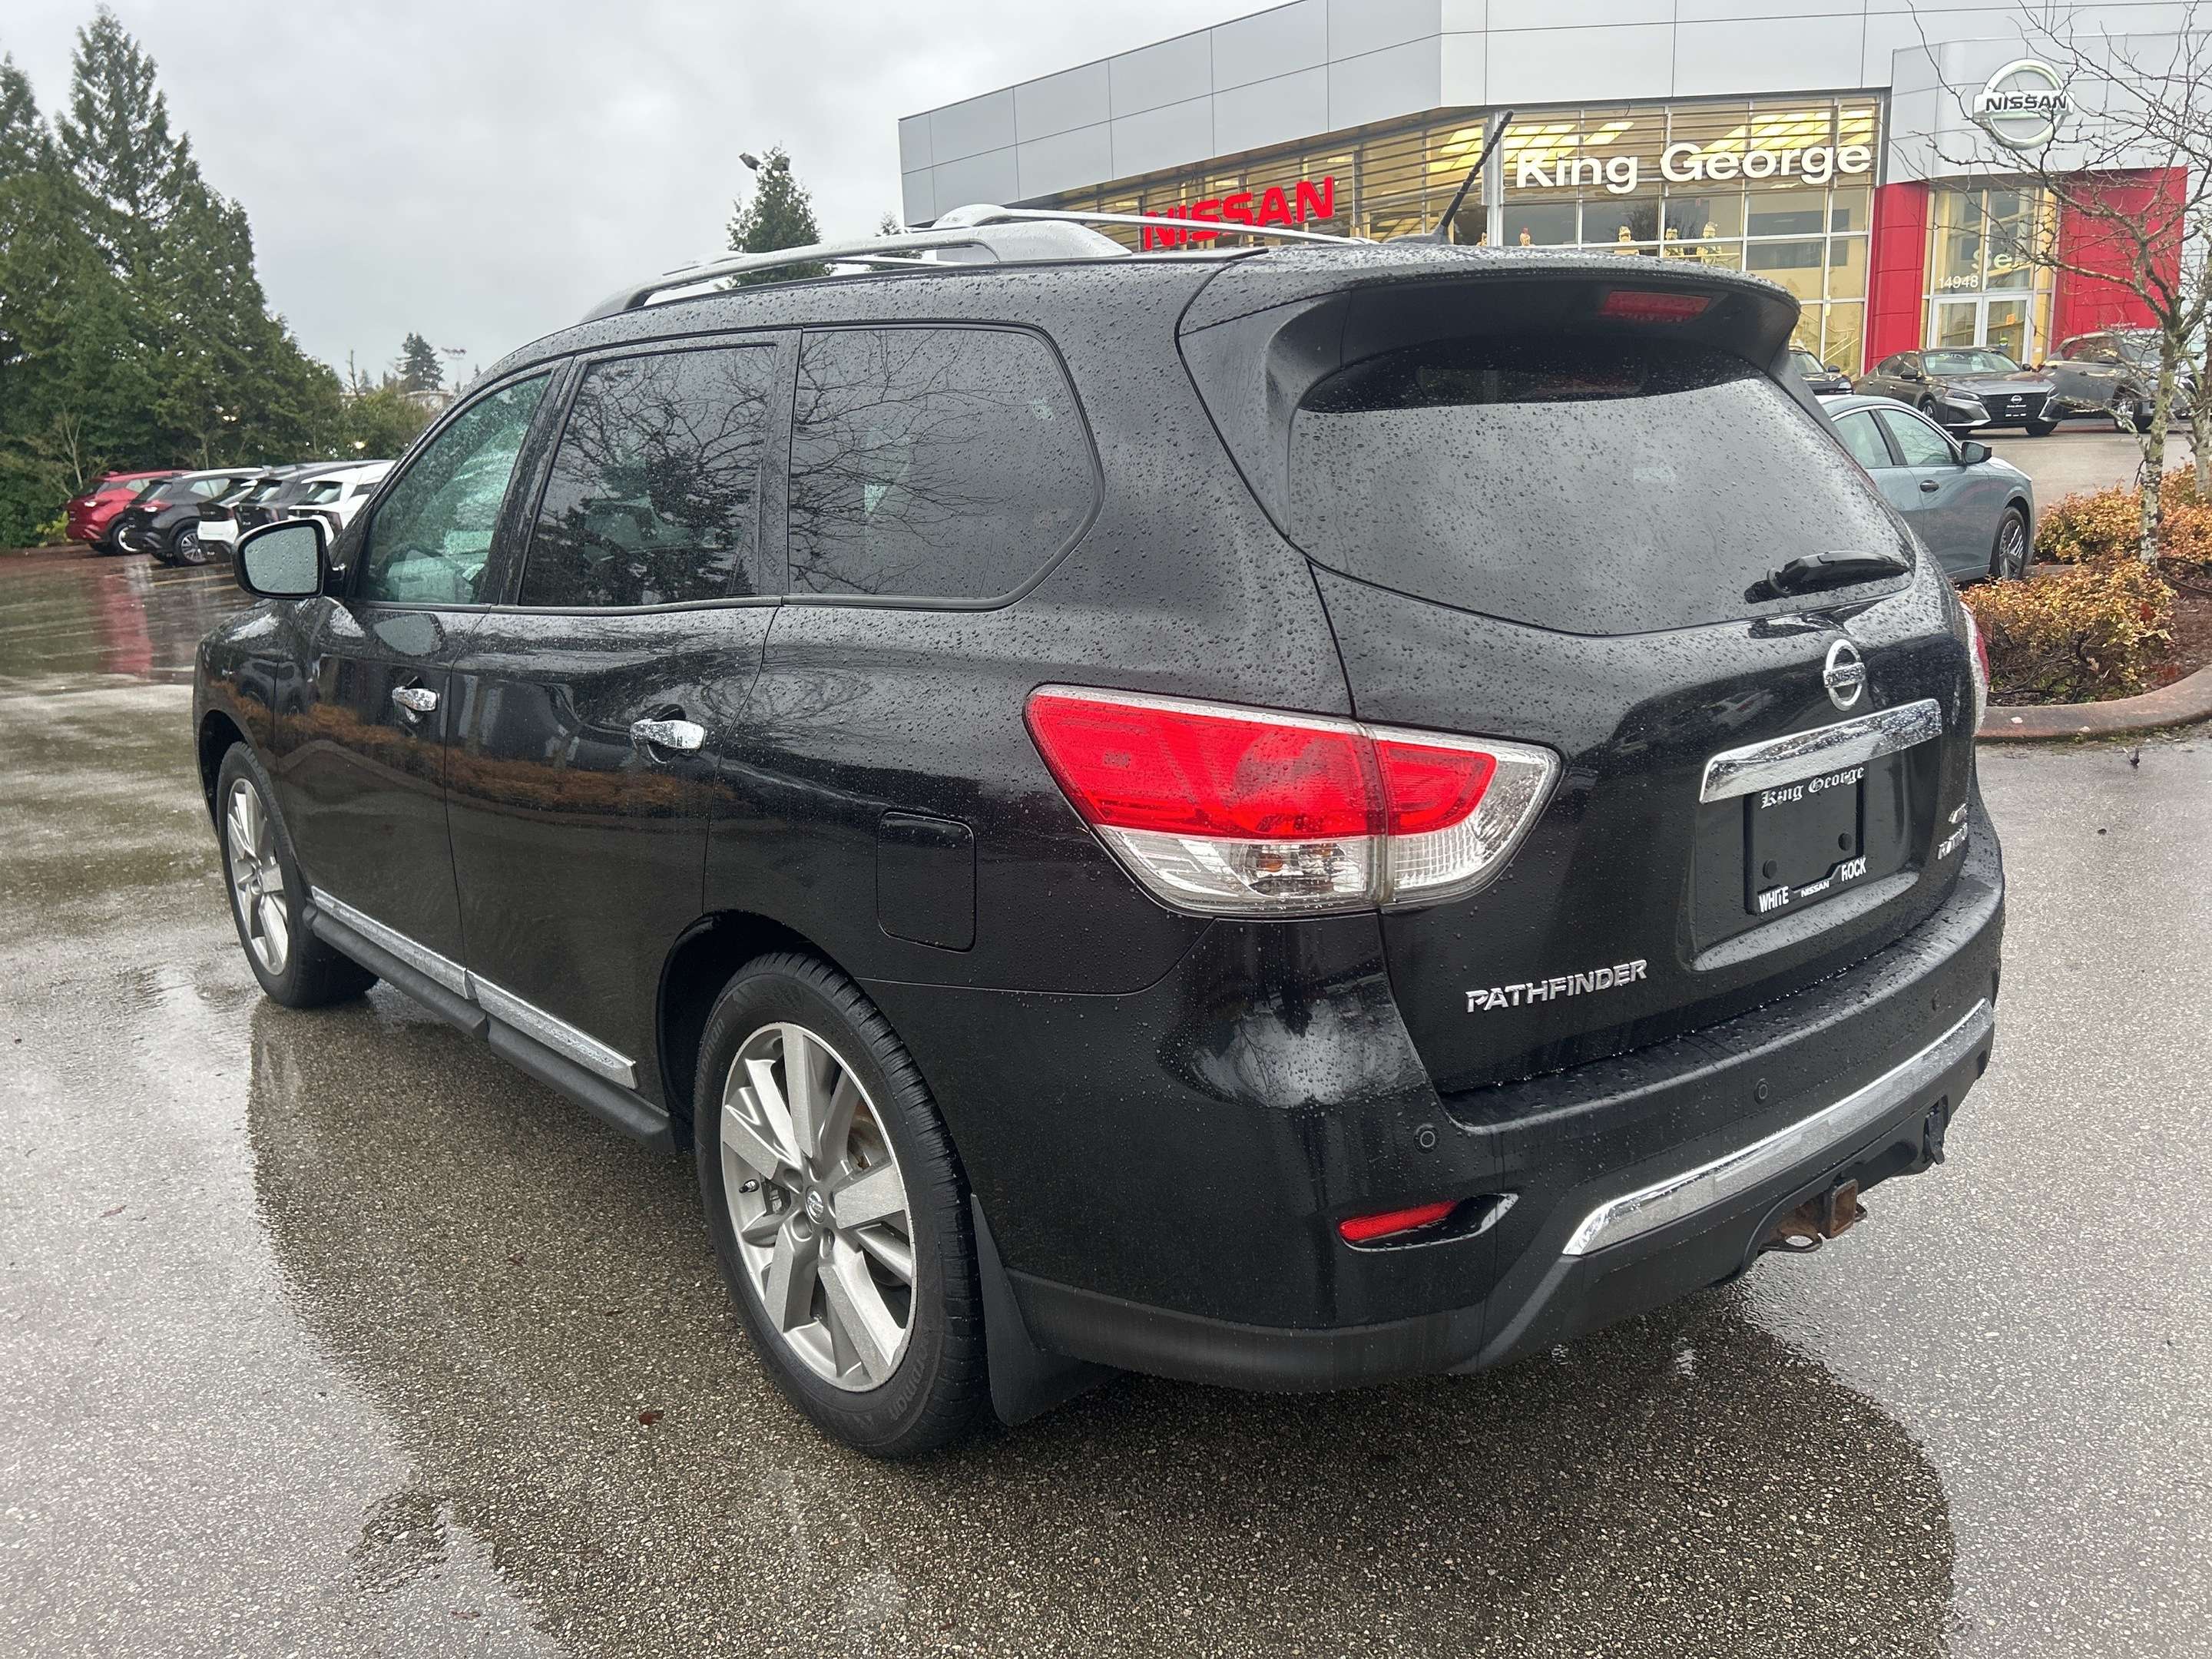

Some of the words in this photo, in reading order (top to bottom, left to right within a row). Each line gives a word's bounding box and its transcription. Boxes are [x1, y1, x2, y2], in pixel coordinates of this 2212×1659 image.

[1985, 95, 2067, 111] NISSAN
[1516, 151, 1638, 194] King
[1659, 143, 1873, 185] George
[1144, 175, 1335, 251] NISSAN
[1938, 275, 1979, 290] 14948
[1760, 785, 1804, 809] King
[1808, 767, 1865, 793] George
[1758, 886, 1790, 912] WHITE
[1841, 856, 1866, 882] ROCK
[1800, 880, 1830, 898] NISSAN
[1465, 959, 1647, 1013] PATHFINDER
